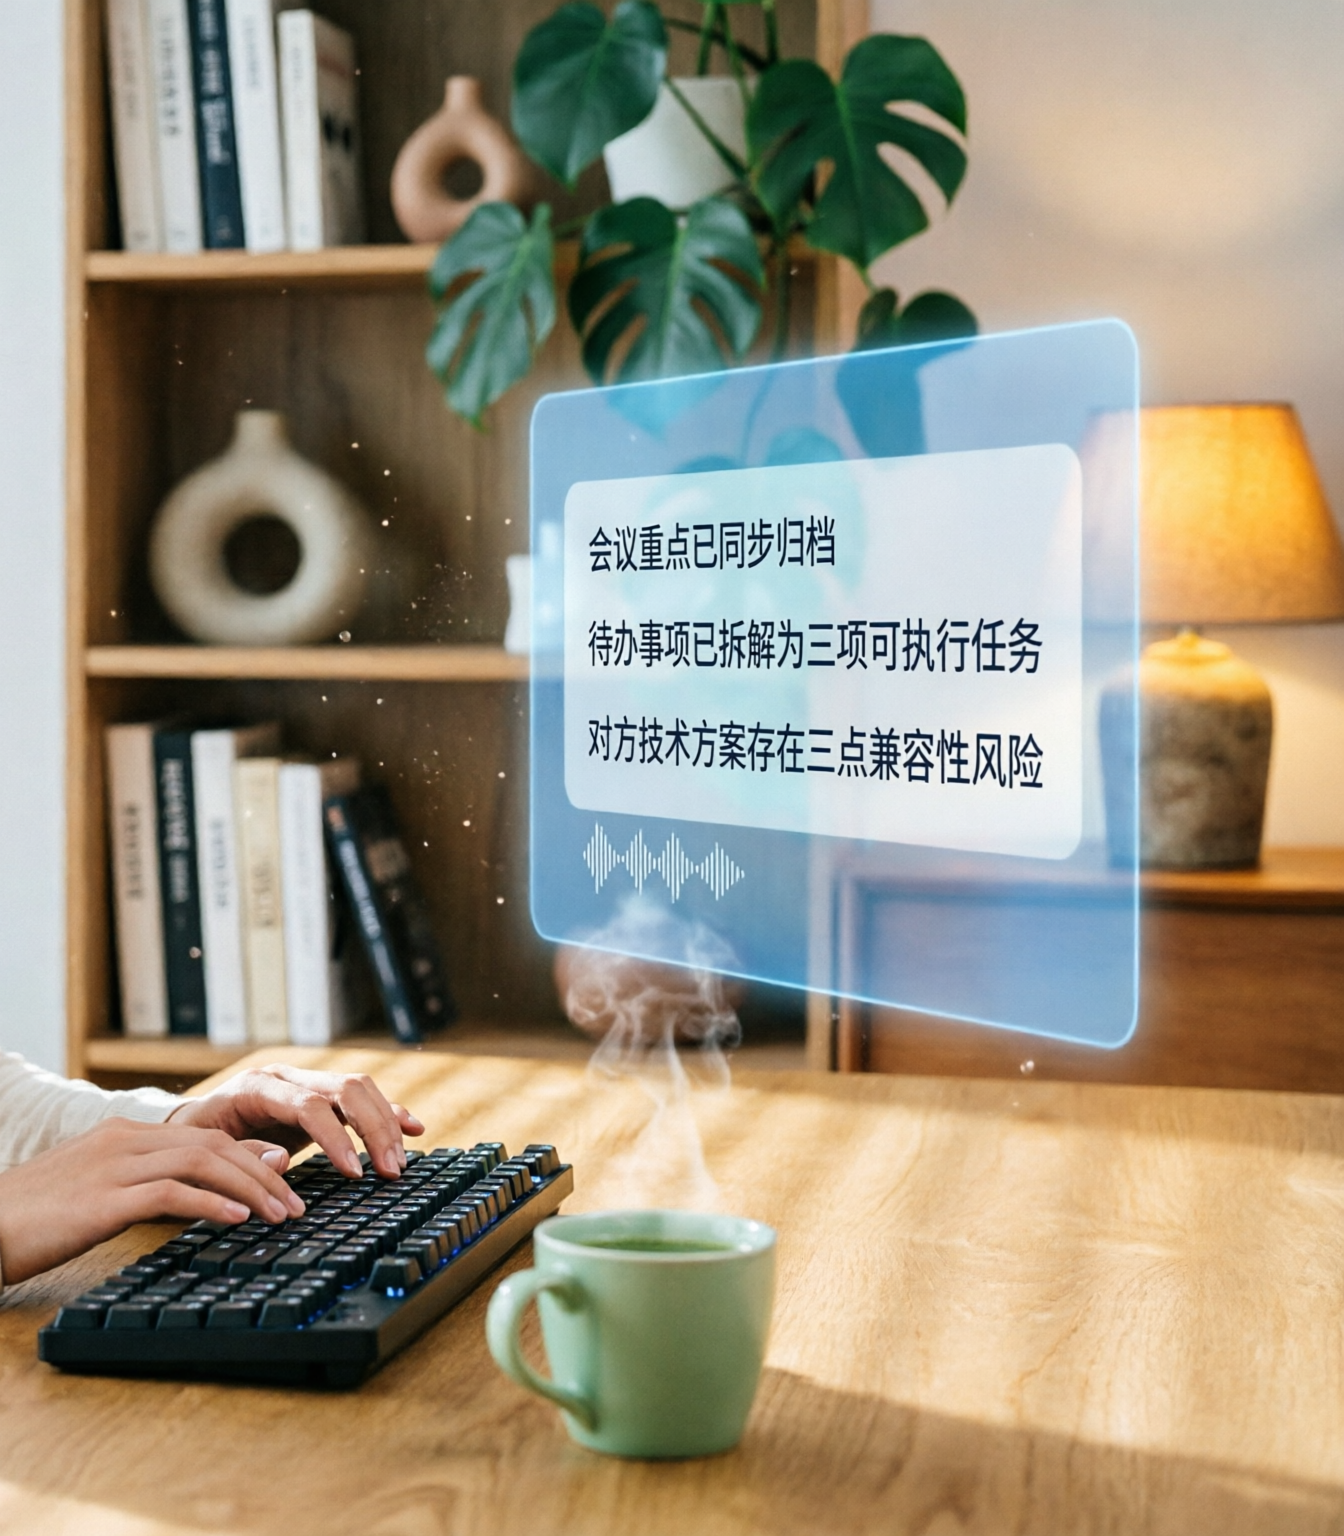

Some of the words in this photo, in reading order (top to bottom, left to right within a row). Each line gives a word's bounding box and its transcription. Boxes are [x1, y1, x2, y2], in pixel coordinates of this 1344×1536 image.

[588, 515, 835, 572] 会议重点已同步归档
[588, 617, 1043, 674] 待办事项已拆解为三项可执行任务
[588, 714, 1044, 789] 对方技术方案存在三点兼容性风险
